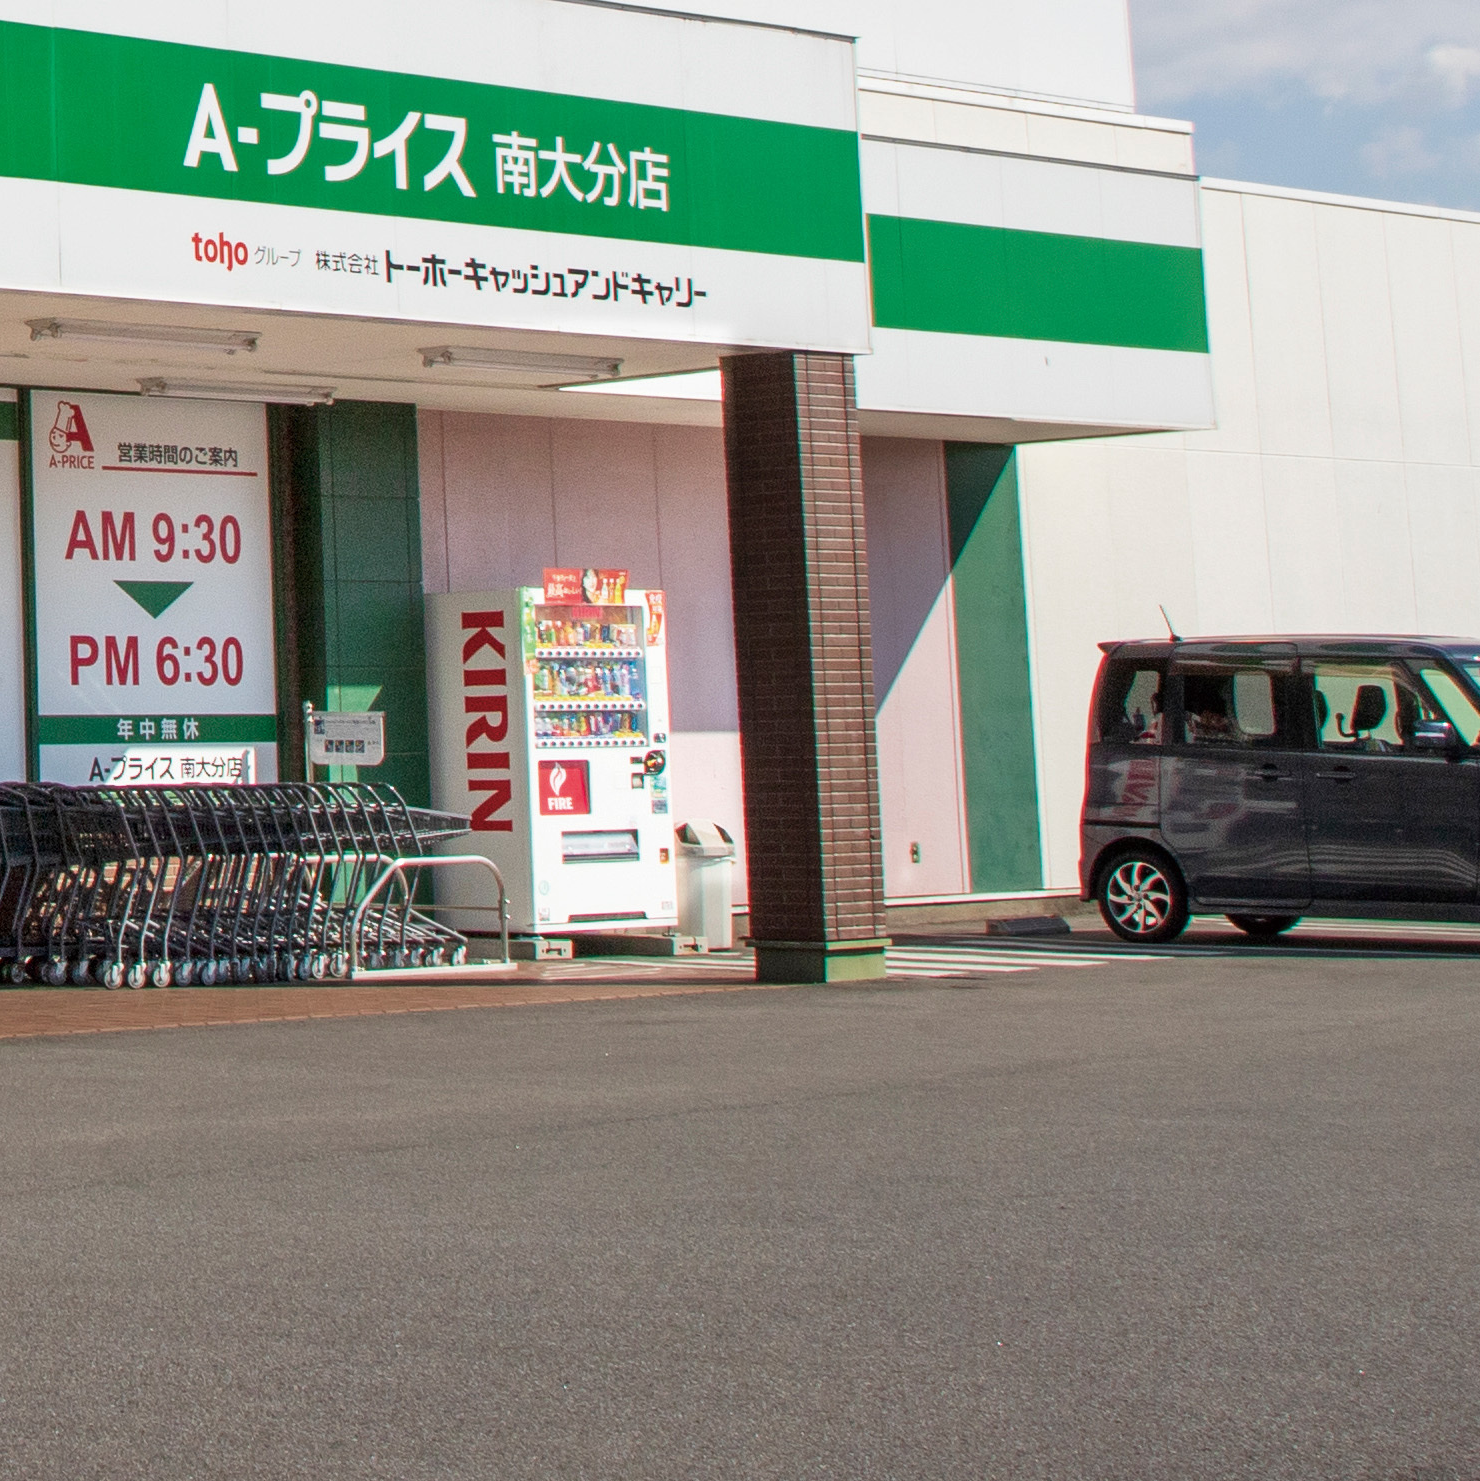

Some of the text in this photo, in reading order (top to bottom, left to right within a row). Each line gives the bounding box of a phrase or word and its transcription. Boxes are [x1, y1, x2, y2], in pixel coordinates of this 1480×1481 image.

[184, 82, 670, 213] A-プライス 南大分店
[191, 231, 707, 308] toho グループ 株式会社 トーホーキャッシュアンドキャリー
[49, 454, 95, 470] A-PRICE
[117, 442, 239, 468] 営業時間のご案内
[65, 509, 242, 565] AM 9:30
[69, 635, 245, 688] PM 6:30
[117, 718, 199, 741] 年中無休
[461, 610, 513, 833] KIRIN
[89, 755, 243, 782] A-プライス 南大分店
[547, 797, 574, 810] FIRE
